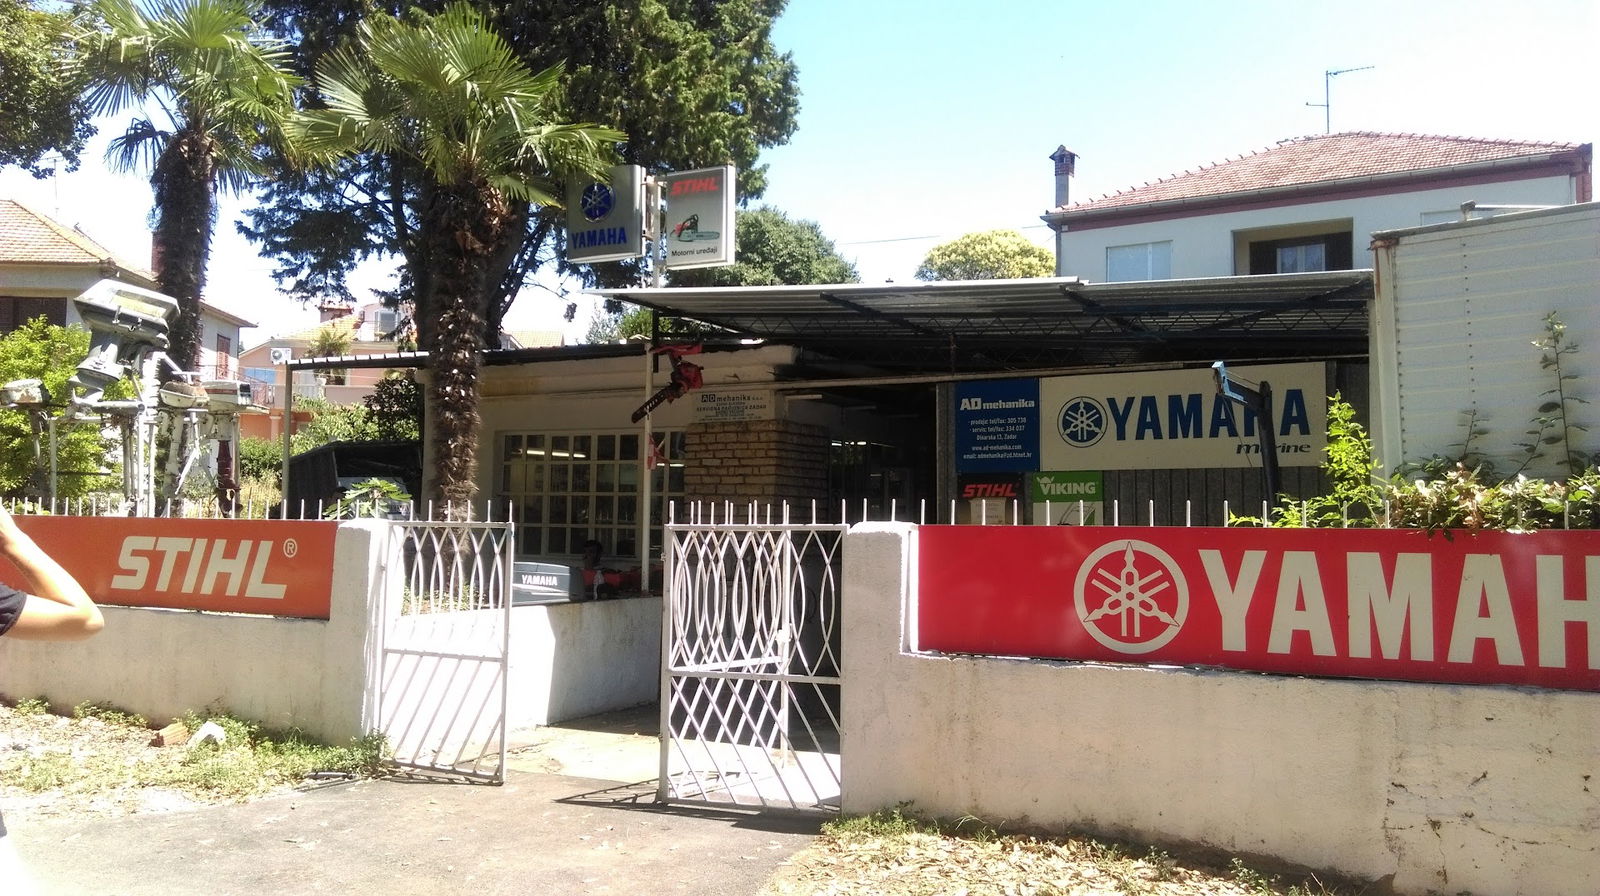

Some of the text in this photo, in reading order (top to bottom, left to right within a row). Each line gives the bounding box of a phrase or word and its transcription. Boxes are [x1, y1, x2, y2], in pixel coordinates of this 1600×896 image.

[671, 177, 718, 195] STIHL
[571, 227, 627, 249] YAMAHA
[671, 249, 695, 257] Motorni
[716, 394, 751, 402] mehanika
[960, 398, 1035, 411] AD mehanika
[1236, 443, 1311, 454] mine
[962, 483, 1017, 498] STIHL
[1040, 482, 1096, 495] VIKING
[111, 535, 288, 600] STIHL
[521, 574, 558, 586] YAMAHA
